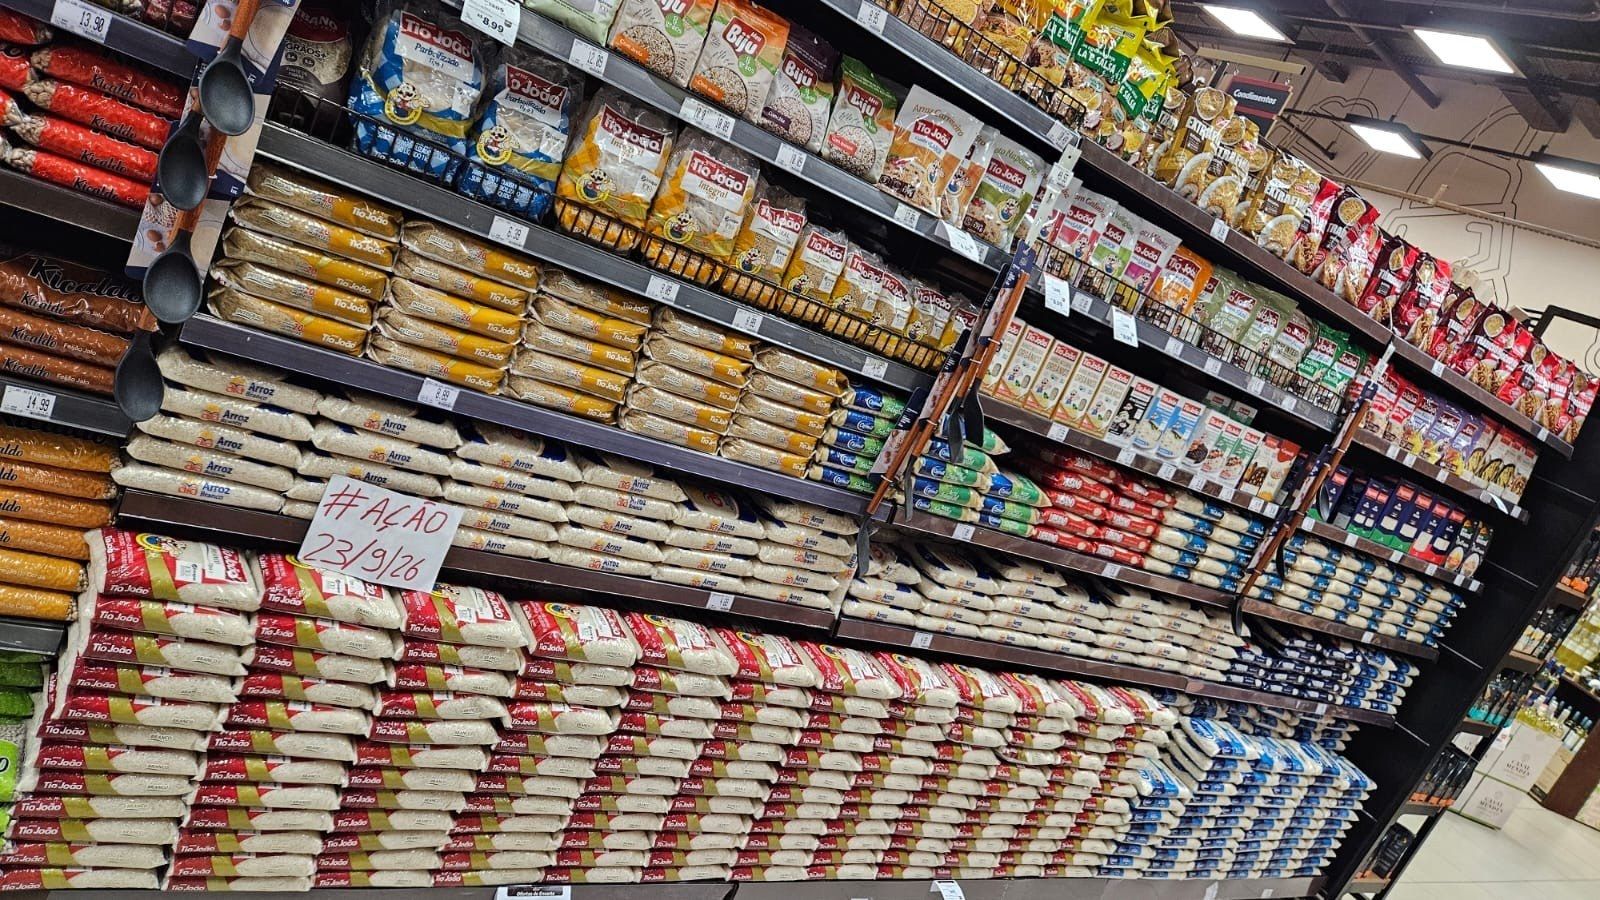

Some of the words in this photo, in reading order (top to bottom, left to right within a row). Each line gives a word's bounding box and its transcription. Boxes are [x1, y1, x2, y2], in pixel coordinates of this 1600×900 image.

[726, 24, 758, 55] Biju
[784, 60, 813, 87] Biju
[90, 73, 137, 100] Kicaldo
[850, 90, 876, 115] Biju
[1233, 87, 1278, 106] Condimentos
[90, 114, 137, 140] Kicaldo
[916, 121, 931, 135] Tio
[931, 128, 952, 145] João
[80, 149, 127, 173] Kicaldo
[989, 161, 1001, 174] Tio
[1001, 166, 1023, 185] João
[72, 176, 120, 200] Kicaldo
[698, 180, 728, 199] Integral
[352, 207, 367, 218] Tio
[368, 212, 389, 226] João
[503, 262, 515, 272] Tio
[516, 265, 532, 278] João
[336, 277, 349, 287] Tio
[350, 280, 372, 294] João
[334, 298, 347, 307] Tio
[348, 301, 367, 314] João
[490, 292, 502, 302] Tio
[502, 296, 519, 307] João
[487, 323, 498, 331] Tio
[499, 325, 516, 336] João
[10, 326, 57, 349] Kicaldo
[322, 333, 335, 344] Tio
[336, 336, 356, 350] João
[475, 348, 486, 357] Tio
[487, 350, 504, 361] João
[2, 358, 50, 378] Kicaldo
[464, 375, 476, 384] Tio
[477, 377, 493, 388] João
[248, 382, 275, 396] Arroz
[27, 395, 49, 412] 14.99
[222, 410, 249, 423] Arroz
[383, 418, 407, 431] Arroz
[216, 437, 242, 450] Arroz
[388, 450, 411, 462] Arroz
[206, 461, 233, 474] Arroz
[514, 459, 534, 469] Arroz
[365, 471, 387, 483] Arroz
[202, 482, 231, 495] Arroz
[507, 479, 526, 491] Arroz
[633, 479, 649, 489] Arroz
[323, 484, 448, 534] #AÇÃO
[500, 500, 520, 510] Arroz
[490, 519, 510, 530] Arroz
[615, 521, 632, 531] Arroz
[720, 522, 735, 531] Arroz
[485, 540, 506, 550] Arroz
[606, 542, 622, 552] Arroz
[303, 533, 426, 581] 23/9/26
[711, 561, 727, 570] Arroz
[110, 584, 124, 593] Tio
[125, 585, 150, 595] João
[100, 611, 114, 620] Tio
[115, 613, 140, 623] João
[261, 628, 273, 636] Tio
[274, 629, 294, 638] João
[93, 642, 107, 652] Tio
[108, 644, 133, 655] João
[408, 650, 418, 658] Tio
[259, 655, 271, 664] Tio
[272, 657, 292, 667] João
[76, 679, 90, 688] Tio
[91, 680, 116, 689] João
[68, 709, 82, 718] Tio
[82, 710, 108, 720] João
[46, 726, 59, 734] Tio
[60, 727, 85, 736] João
[42, 757, 57, 766] Tio
[58, 758, 82, 767] João
[58, 782, 82, 790] João
[351, 776, 363, 784] Tio
[21, 802, 35, 811] Tio
[36, 802, 62, 812] João
[19, 826, 32, 835] Tio
[33, 827, 59, 835] João
